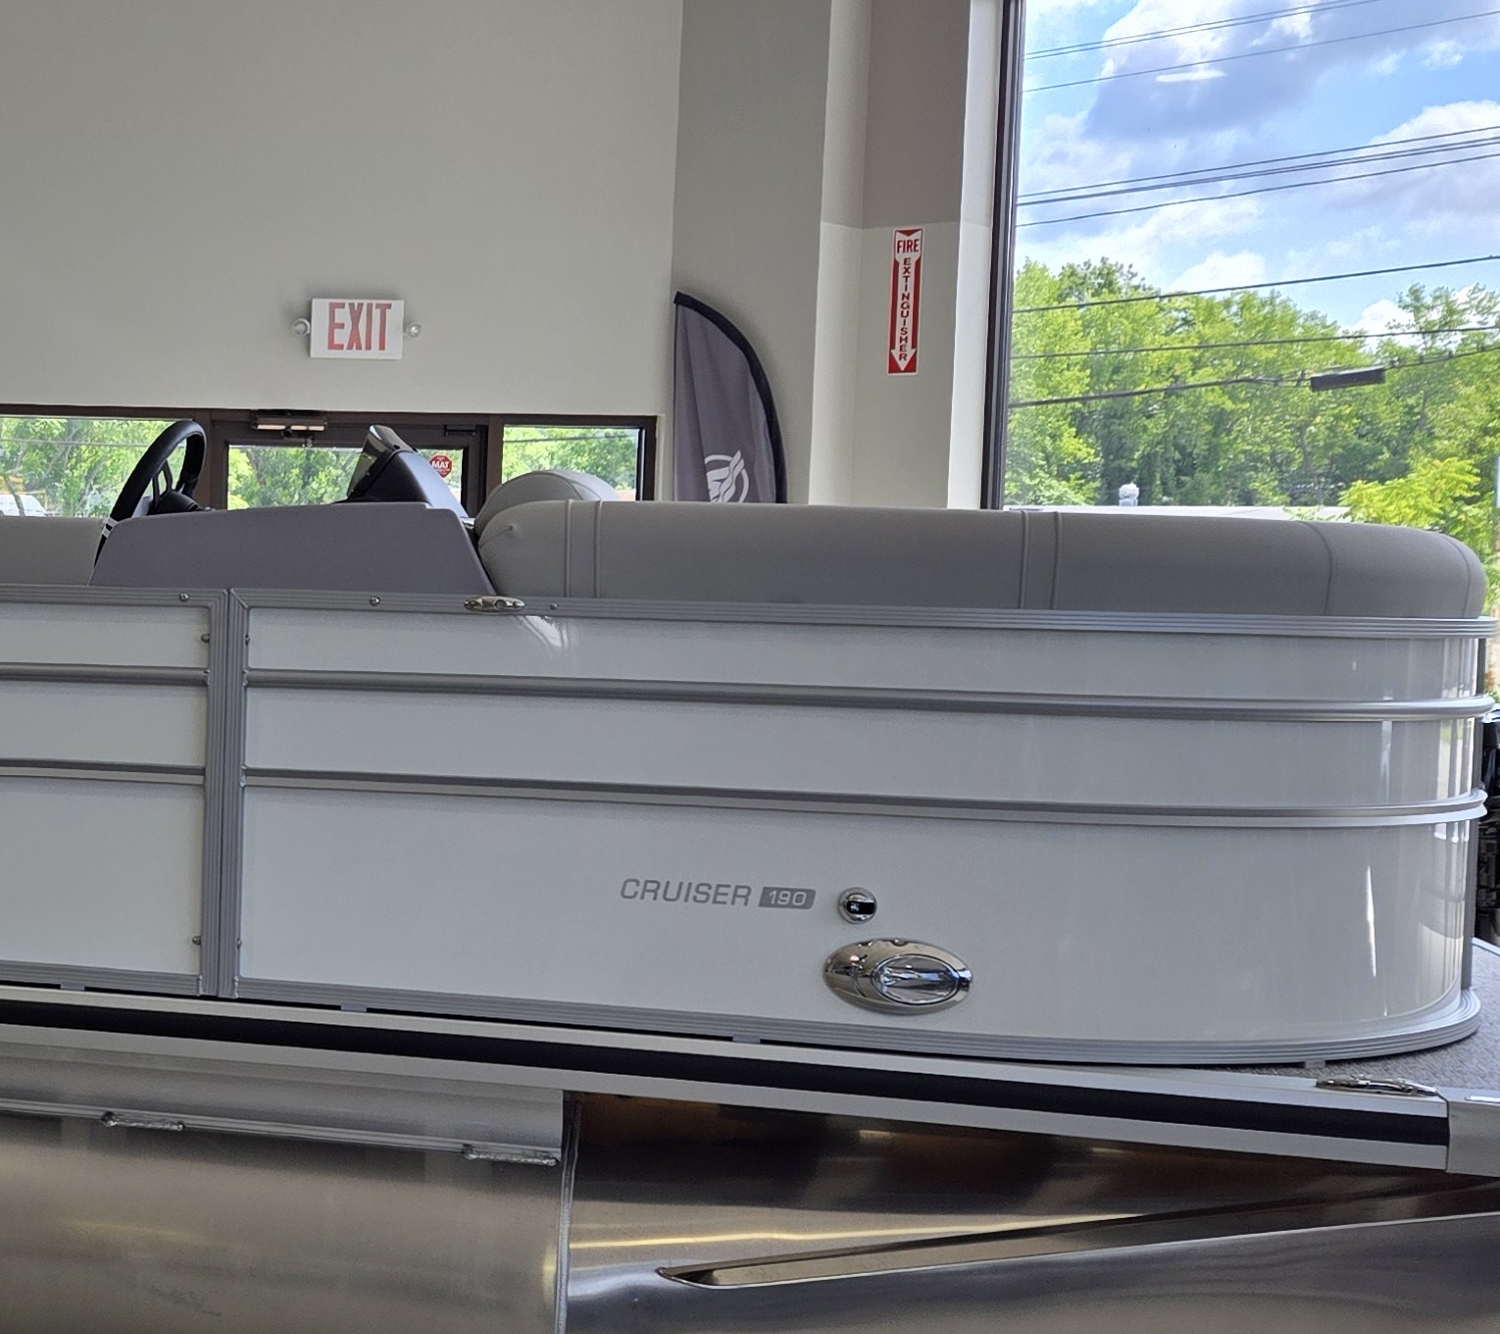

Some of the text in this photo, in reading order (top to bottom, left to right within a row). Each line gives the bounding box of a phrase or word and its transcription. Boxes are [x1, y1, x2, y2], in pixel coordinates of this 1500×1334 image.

[897, 239, 920, 254] FIRE
[327, 302, 392, 351] EXIT
[898, 257, 912, 362] EXTINGUISHER
[620, 878, 807, 906] CRUISER 190
